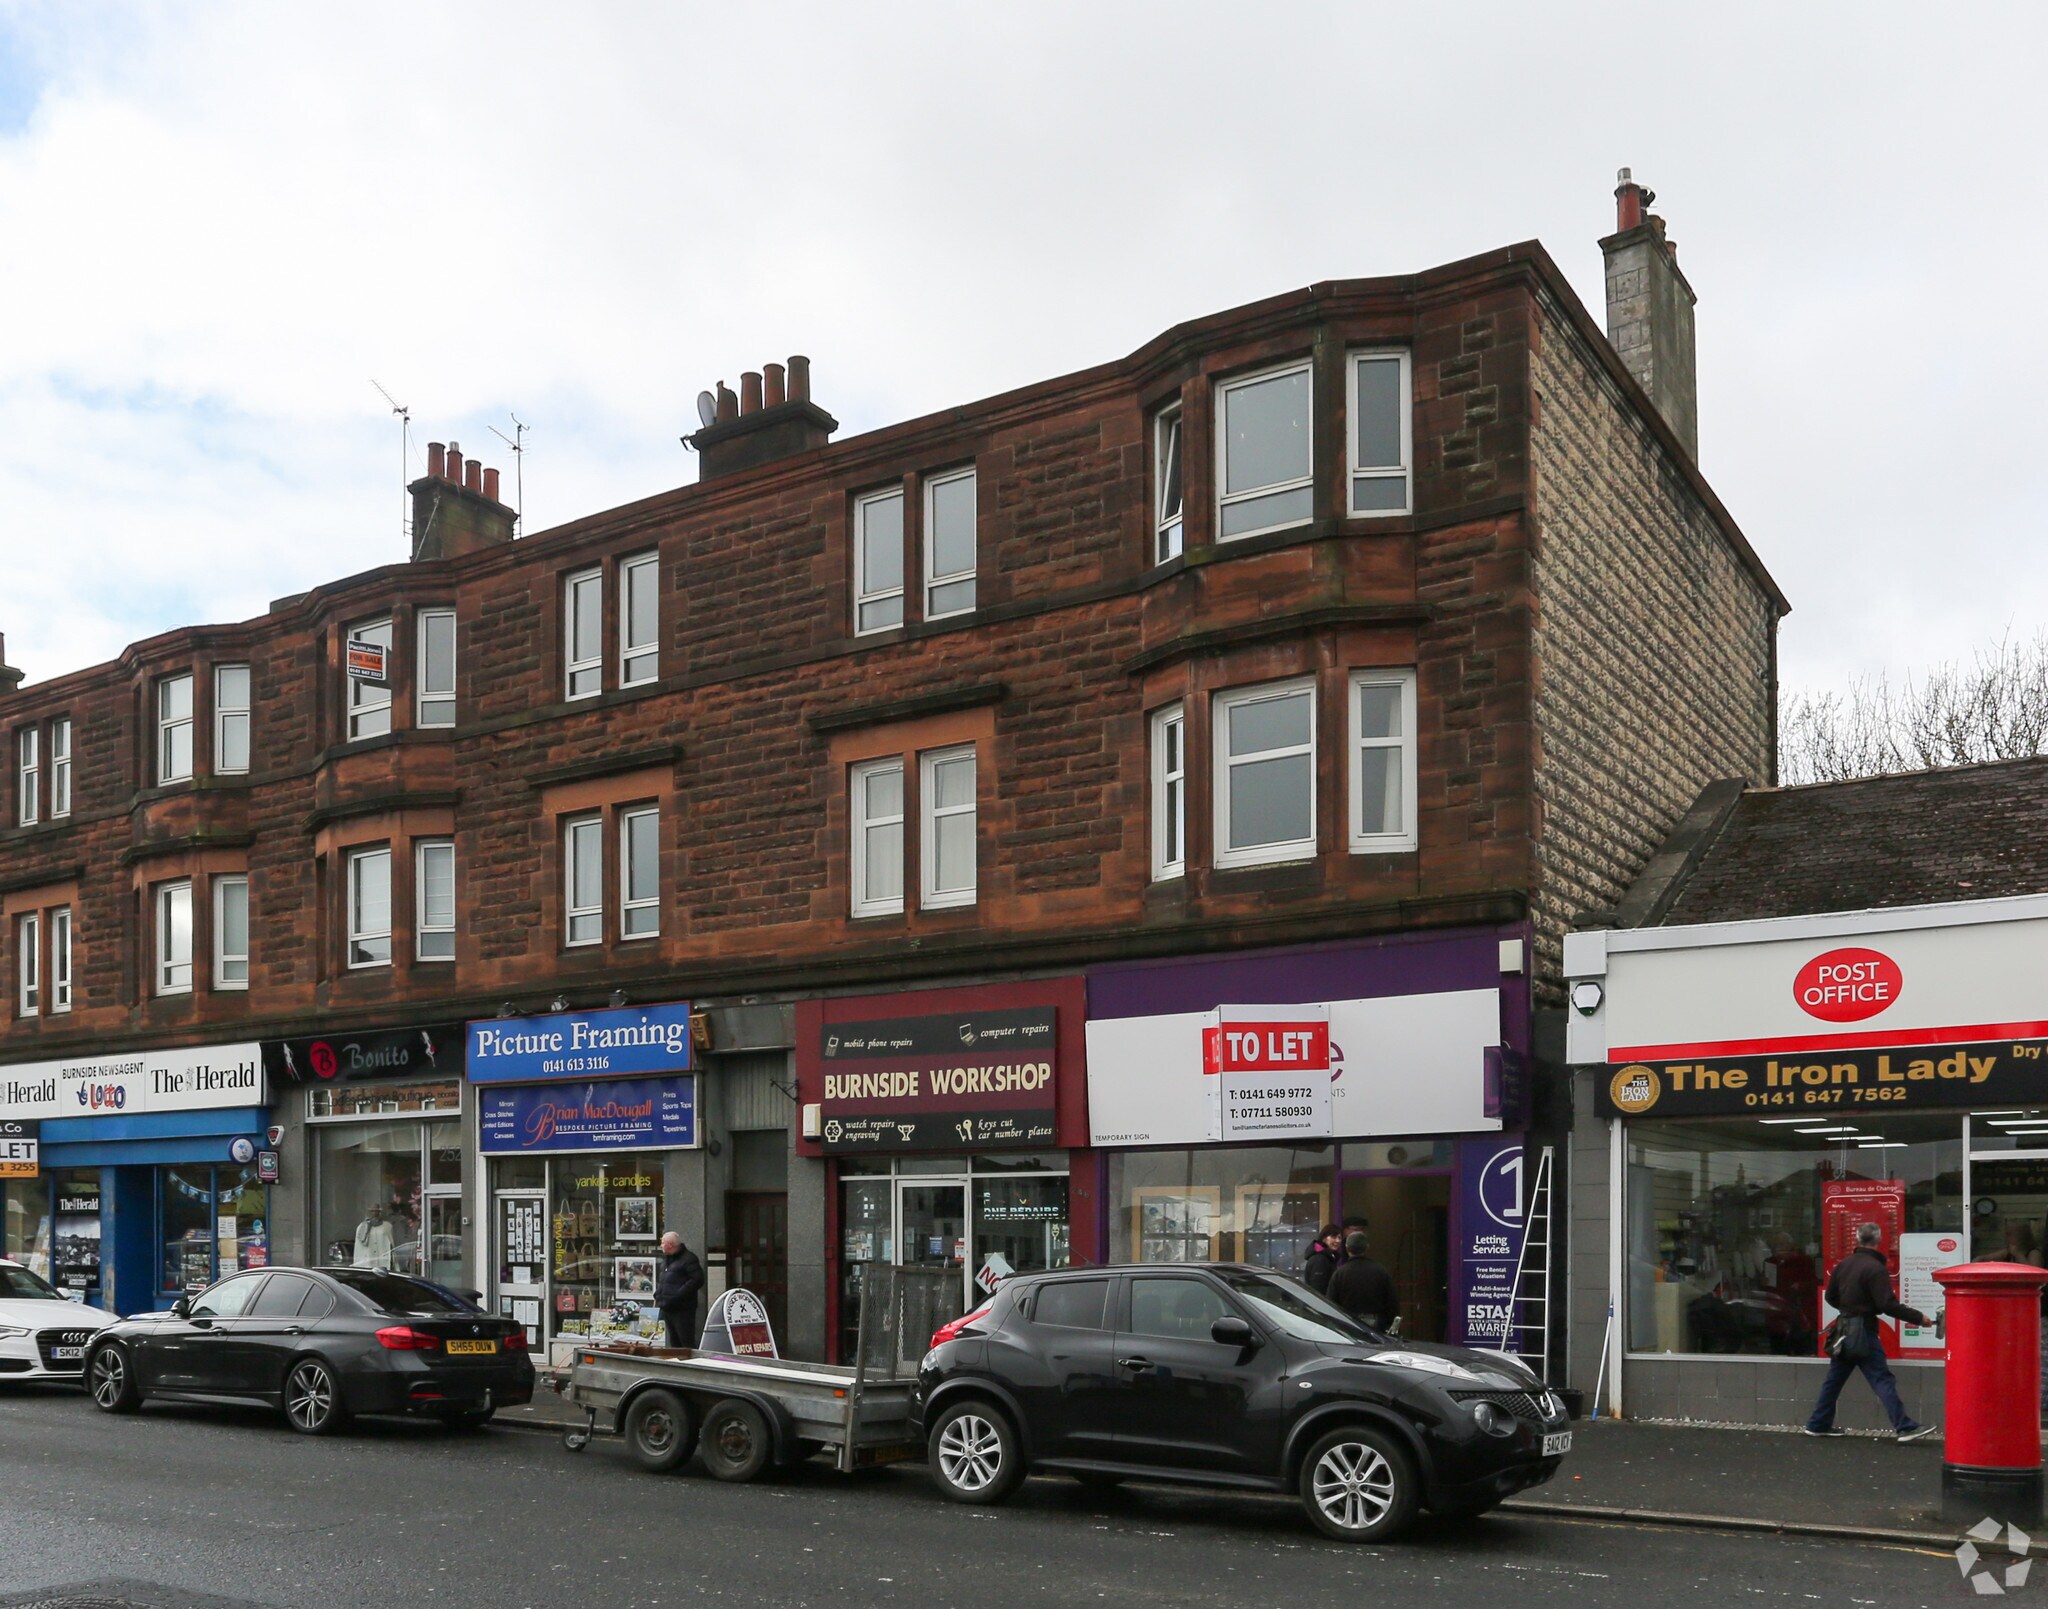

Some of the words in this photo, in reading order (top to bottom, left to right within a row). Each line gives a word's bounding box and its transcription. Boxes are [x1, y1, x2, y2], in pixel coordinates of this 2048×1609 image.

[1818, 961, 1880, 984] POST
[1803, 982, 1888, 1006] OFFICE
[476, 1029, 563, 1058] Picture
[570, 1016, 684, 1054] Framing
[980, 1026, 1016, 1038] computer
[1022, 1024, 1049, 1035] repairs
[844, 1038, 864, 1048] mobile
[868, 1038, 887, 1049] phone
[890, 1038, 913, 1048] repairs
[1226, 1032, 1260, 1062] TO
[1268, 1032, 1313, 1061] LET
[342, 1043, 408, 1069] Bonito
[2013, 1045, 2041, 1060] Dry
[543, 1059, 564, 1072] 0141
[567, 1058, 584, 1071] 613
[587, 1056, 609, 1070] 3116
[62, 1066, 96, 1079] BURNSIDE
[98, 1062, 144, 1076] NEWSAGENT
[1665, 1063, 1748, 1091] The
[1767, 1060, 1858, 1087] Iron
[1878, 1051, 1997, 1084] Lady
[151, 1069, 184, 1094] The
[196, 1062, 256, 1091] Herald
[824, 1072, 918, 1099] BURNSIDE
[930, 1062, 1050, 1095] WORKSHOP
[8, 1078, 55, 1104] Herald
[1230, 1090, 1238, 1100] T:
[1240, 1090, 1265, 1099] 0141
[1267, 1089, 1285, 1098] 649
[1288, 1088, 1312, 1098] 9772
[1745, 1092, 1794, 1106] 0141
[1804, 1090, 1844, 1104] 647
[1852, 1087, 1906, 1101] 7562
[1621, 1094, 1650, 1102] LADY
[662, 1102, 679, 1110] Sports
[680, 1101, 692, 1109] Tops
[1230, 1109, 1238, 1118] T:
[1241, 1108, 1272, 1118] 07711
[1276, 1106, 1312, 1116] 580930
[4, 1123, 22, 1132] Co
[522, 1103, 578, 1146] Brian
[583, 1100, 652, 1122] MacDougall
[556, 1124, 585, 1132] BESPOKE
[846, 1120, 867, 1128] watch
[870, 1120, 895, 1130] repairs
[978, 1119, 996, 1129] keys
[1000, 1119, 1013, 1127] cut
[845, 1130, 880, 1142] engraving
[995, 1130, 1022, 1138] number
[1028, 1127, 1052, 1138] plates
[1095, 1134, 1132, 1142] TEMPORARY
[10, 1162, 35, 1171] 3255
[575, 1175, 609, 1190] yankee
[612, 1173, 650, 1187] candles
[60, 1199, 72, 1210] The
[76, 1198, 98, 1210] Herald
[1476, 1235, 1508, 1246] Letting
[1473, 1245, 1510, 1254] Services
[60, 1349, 80, 1357] SK12
[451, 1342, 474, 1352] SH65
[476, 1342, 492, 1352] OUW
[736, 1344, 753, 1353] WATCH
[753, 1343, 772, 1352] REPAIRS
